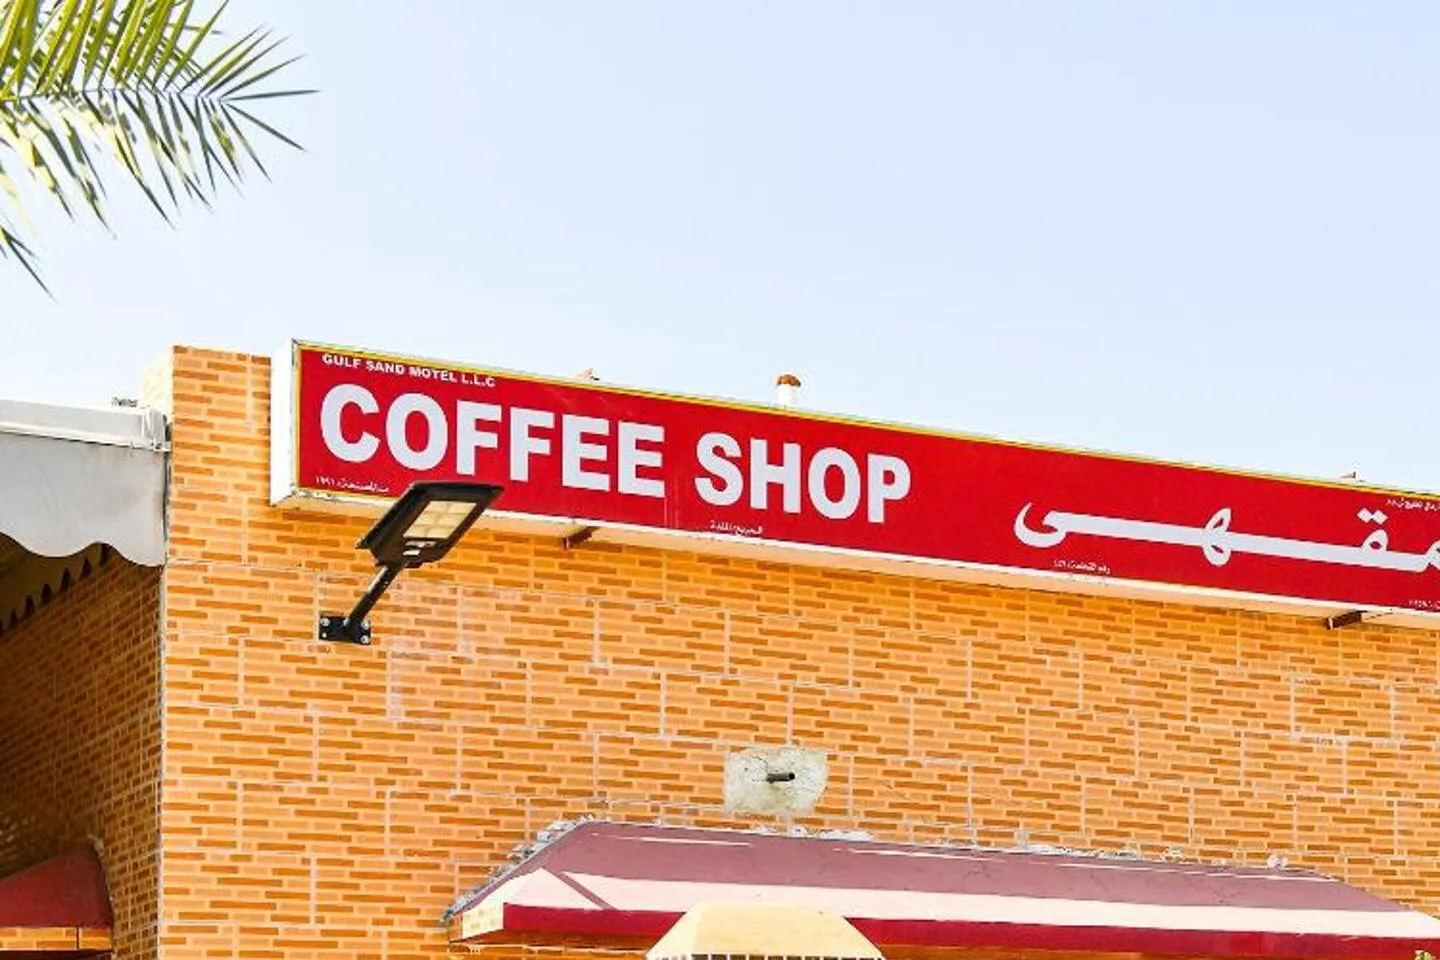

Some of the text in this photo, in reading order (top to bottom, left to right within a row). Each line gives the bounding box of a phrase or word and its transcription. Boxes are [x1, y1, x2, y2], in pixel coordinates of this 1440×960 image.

[322, 353, 361, 369] GULF
[366, 360, 405, 376] SAND
[409, 366, 458, 383] MOTEL
[319, 383, 911, 524] COFFEE SHOP
